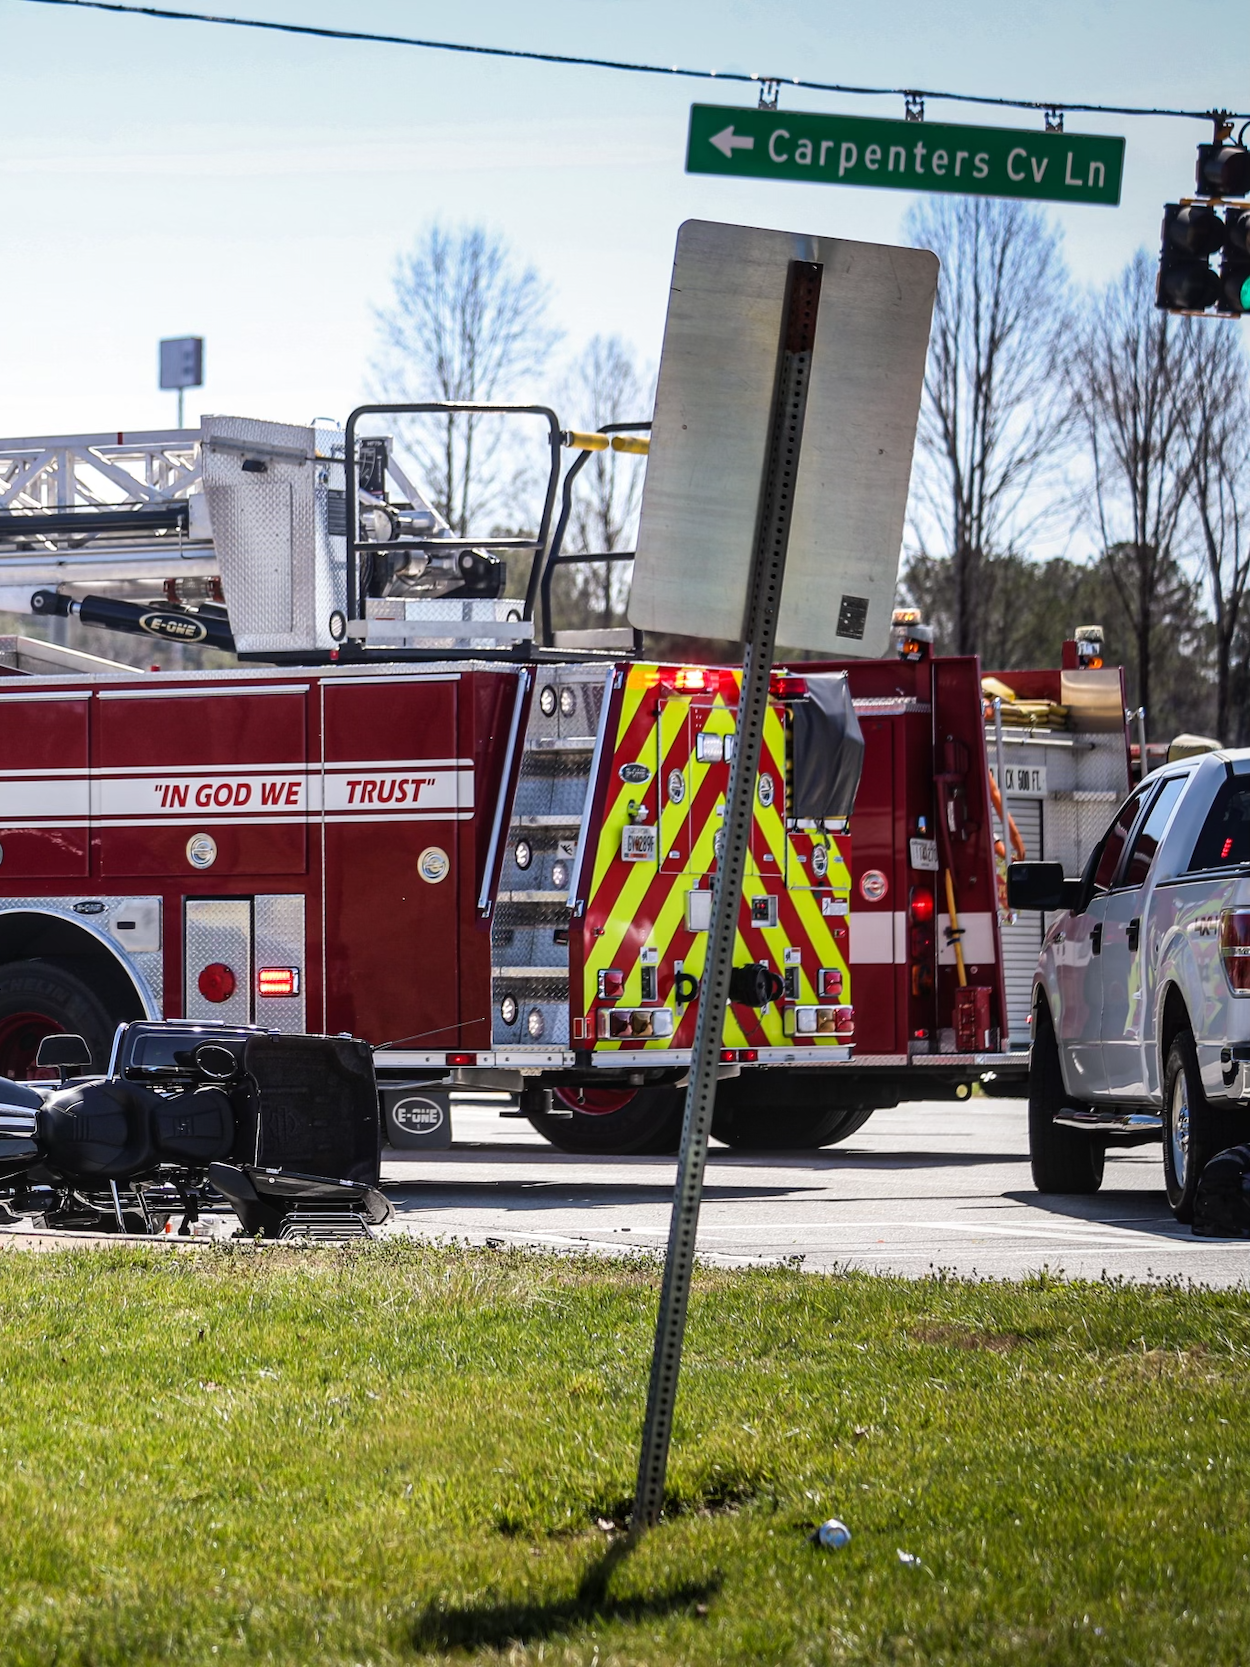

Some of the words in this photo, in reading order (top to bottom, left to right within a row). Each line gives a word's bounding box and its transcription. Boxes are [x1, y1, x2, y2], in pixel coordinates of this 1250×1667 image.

[768, 129, 990, 178] Carpenters
[1006, 147, 1049, 183] Cv
[1064, 151, 1106, 188] Ln
[150, 617, 198, 637] E-ONE
[1017, 769, 1030, 791] 500
[154, 783, 190, 808] "IN
[195, 782, 253, 807] GOD
[261, 781, 302, 806] WE
[346, 778, 436, 804] TRUST"
[397, 1108, 438, 1124] E-ONE
